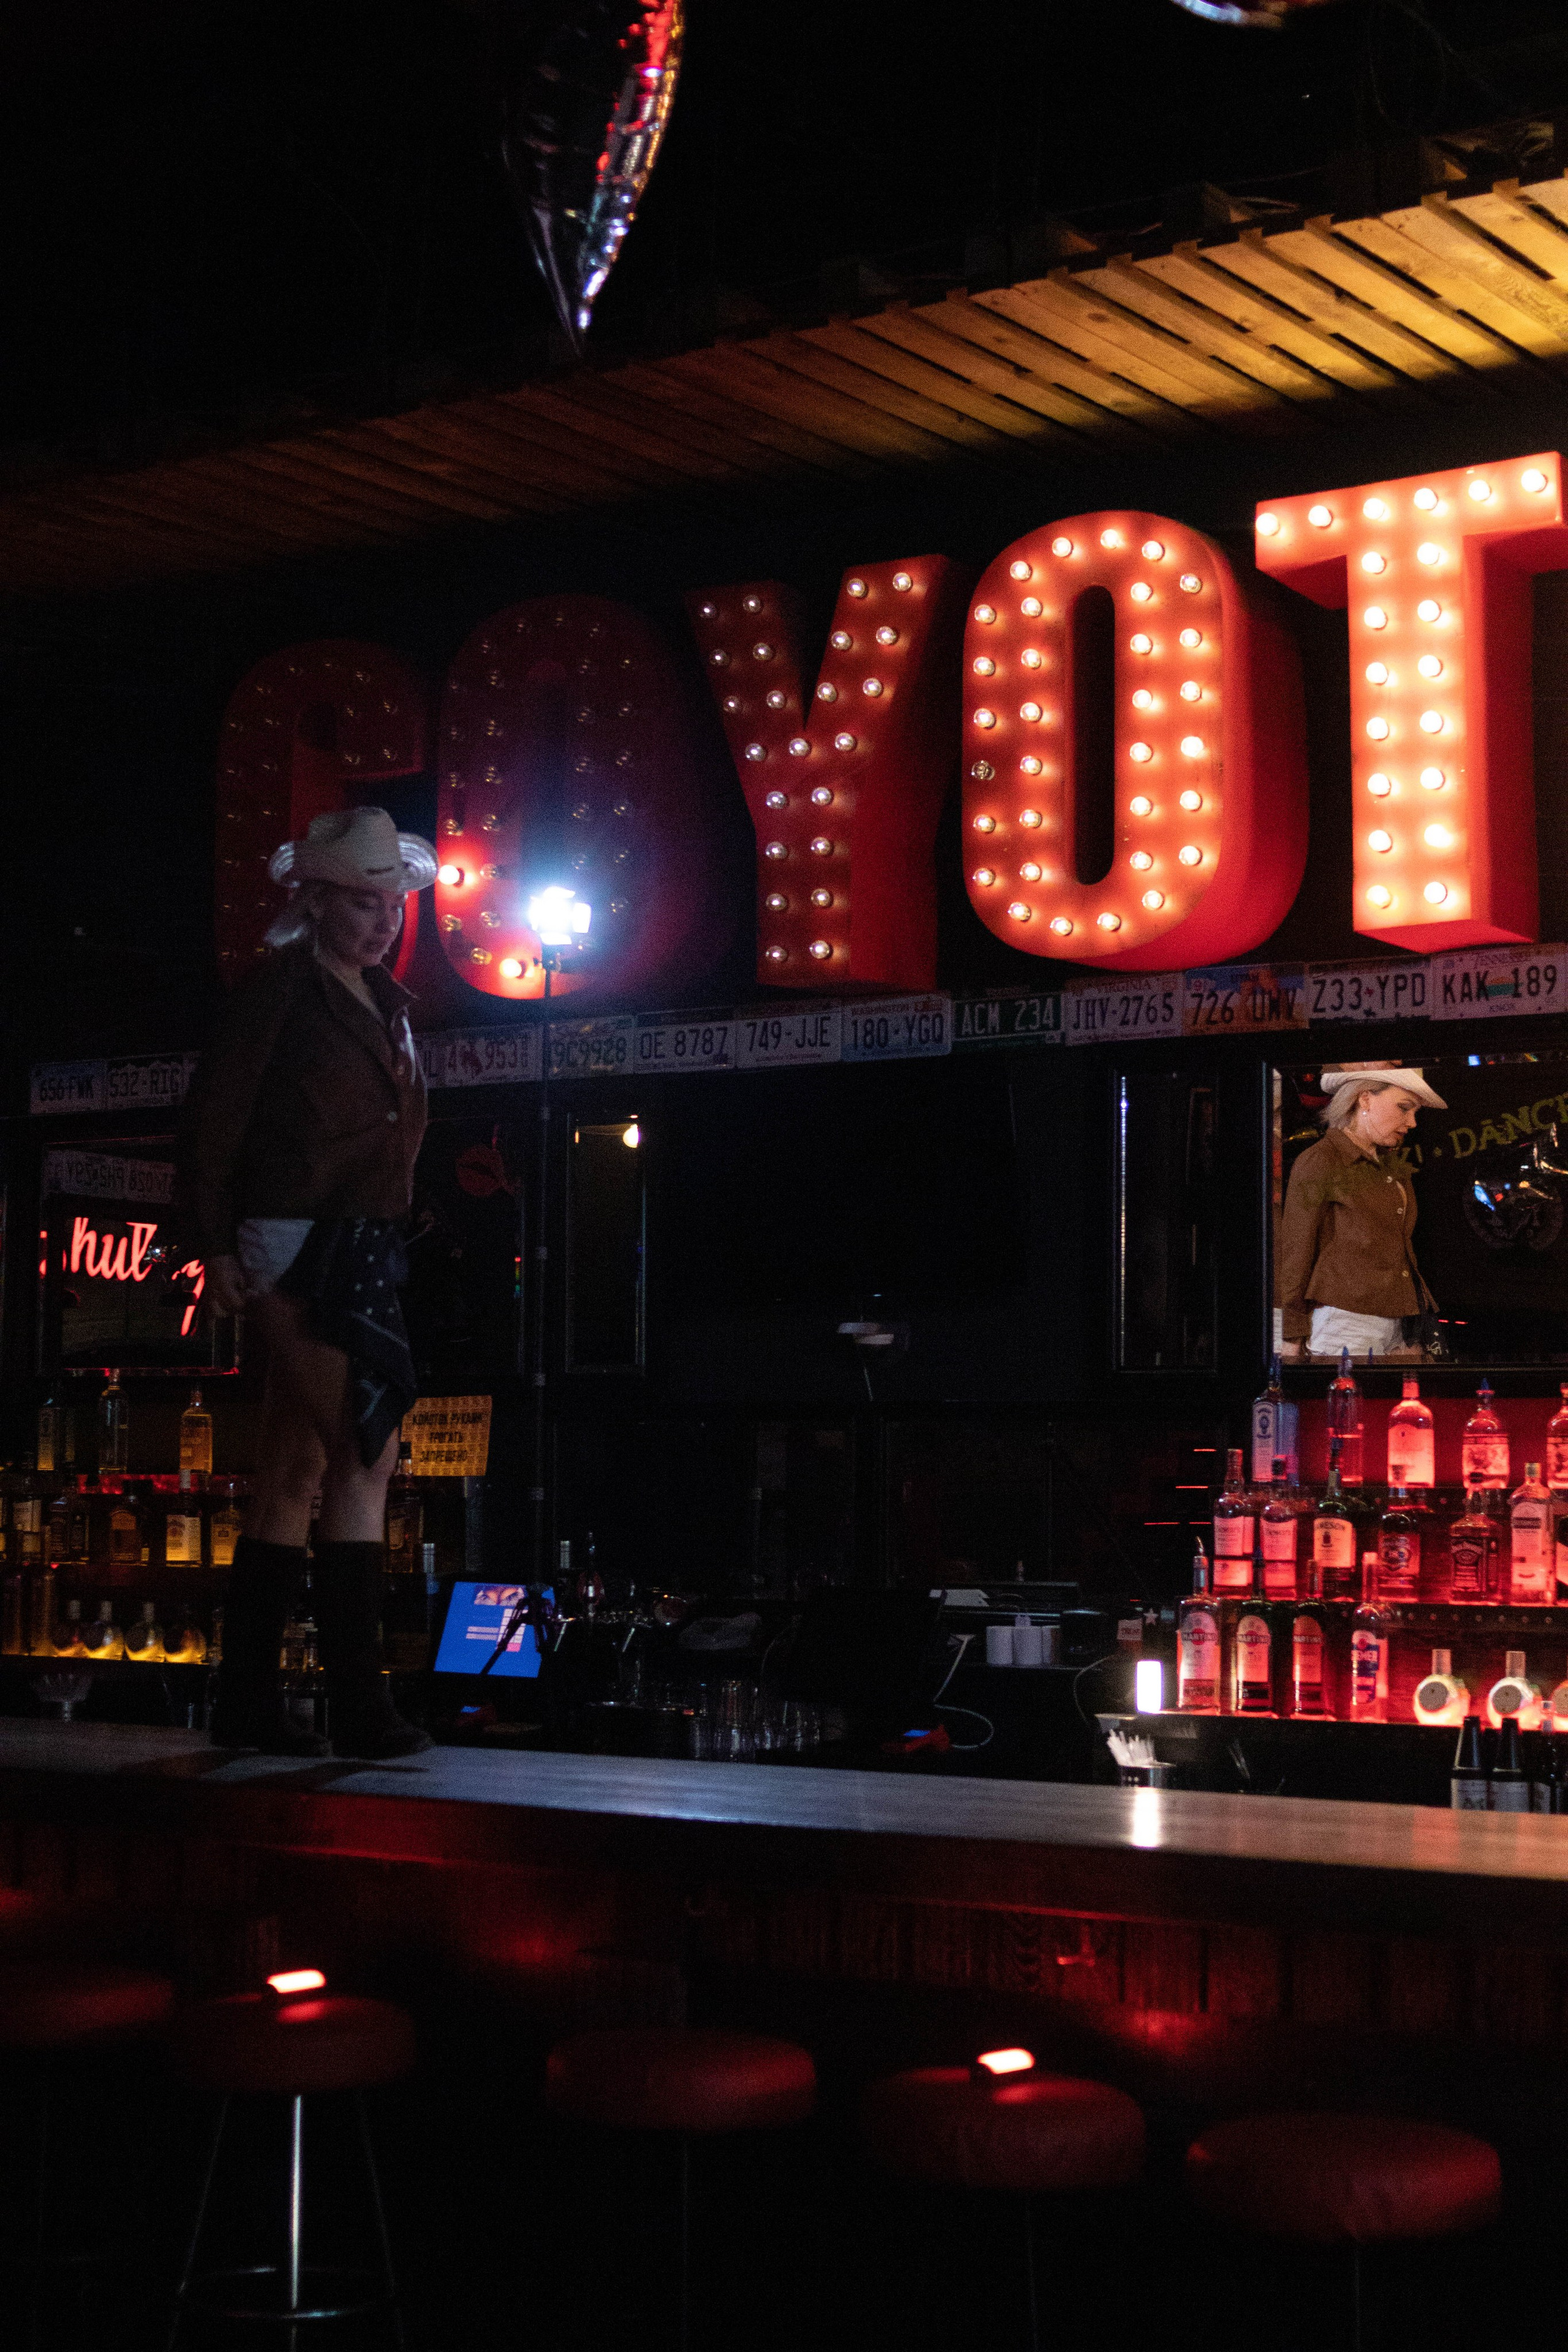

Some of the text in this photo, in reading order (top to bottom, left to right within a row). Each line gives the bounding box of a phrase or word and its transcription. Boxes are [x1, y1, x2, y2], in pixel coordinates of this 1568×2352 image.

[1376, 973, 1425, 1009] YPD
[1442, 964, 1557, 1005] KAK 189
[961, 997, 1054, 1036] ACM 234
[1191, 992, 1234, 1025] 726
[746, 1016, 831, 1052] 749-JJE
